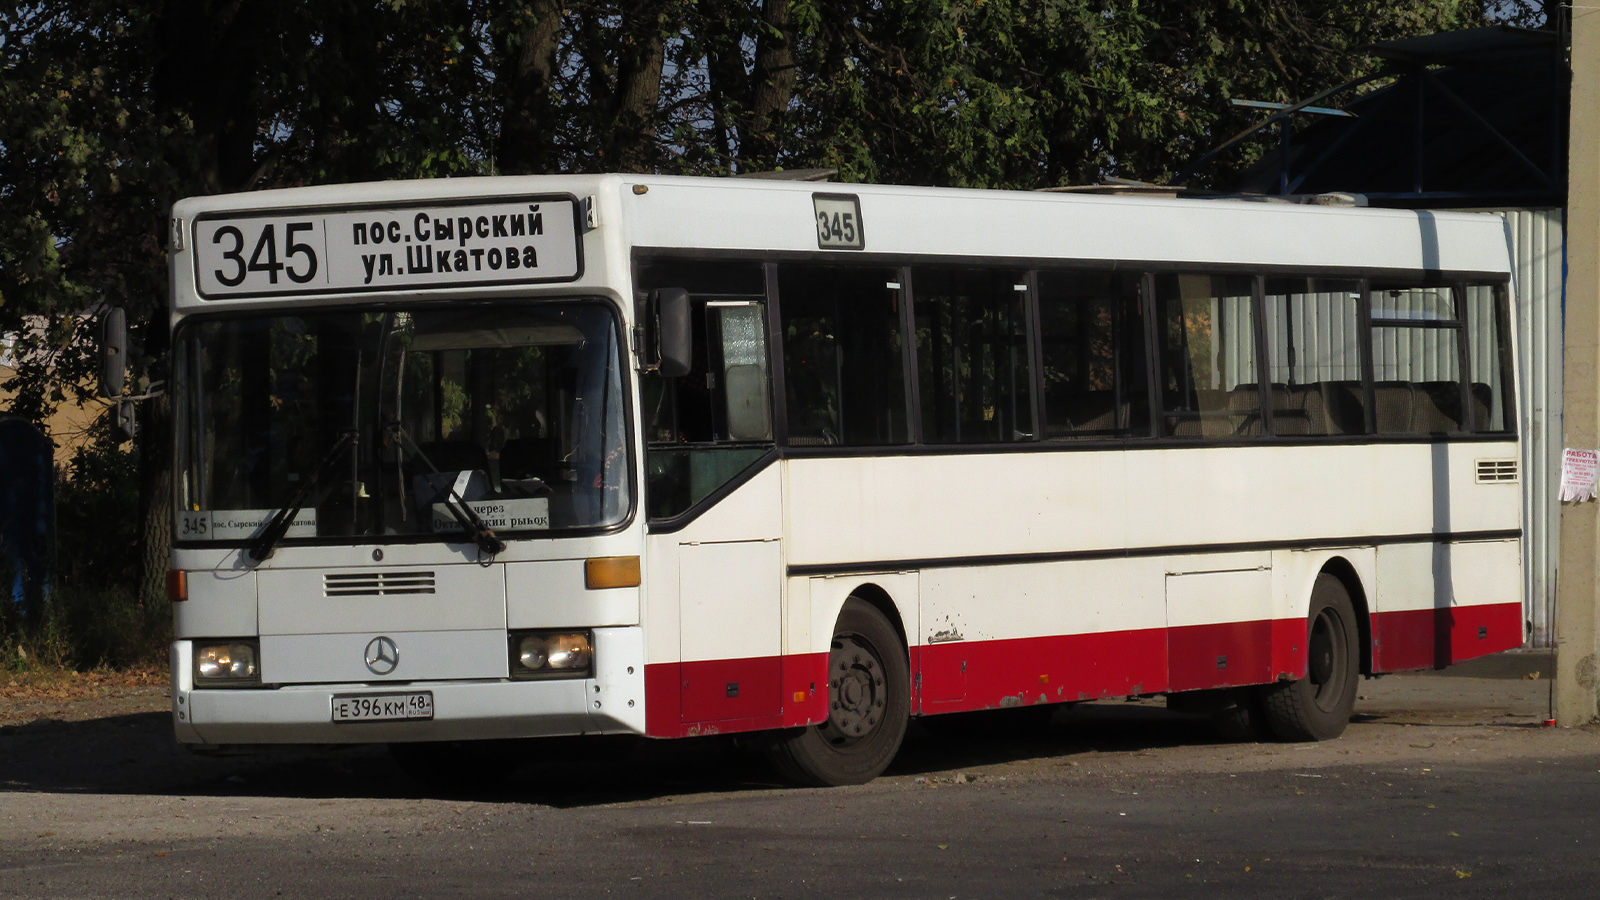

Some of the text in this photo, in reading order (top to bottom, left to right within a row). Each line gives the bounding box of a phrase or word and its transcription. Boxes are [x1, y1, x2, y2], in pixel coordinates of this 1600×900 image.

[353, 204, 544, 246] пос.Сырский
[818, 211, 855, 243] 345
[212, 221, 318, 287] 345
[361, 244, 538, 284] ул.Шкатова
[1566, 450, 1597, 459] РАБОТА
[1566, 457, 1598, 465] ТРЕБУЮТСЯ
[474, 504, 505, 516] через
[182, 518, 207, 535] 345
[227, 518, 263, 530] Сырский
[409, 696, 425, 709] 48
